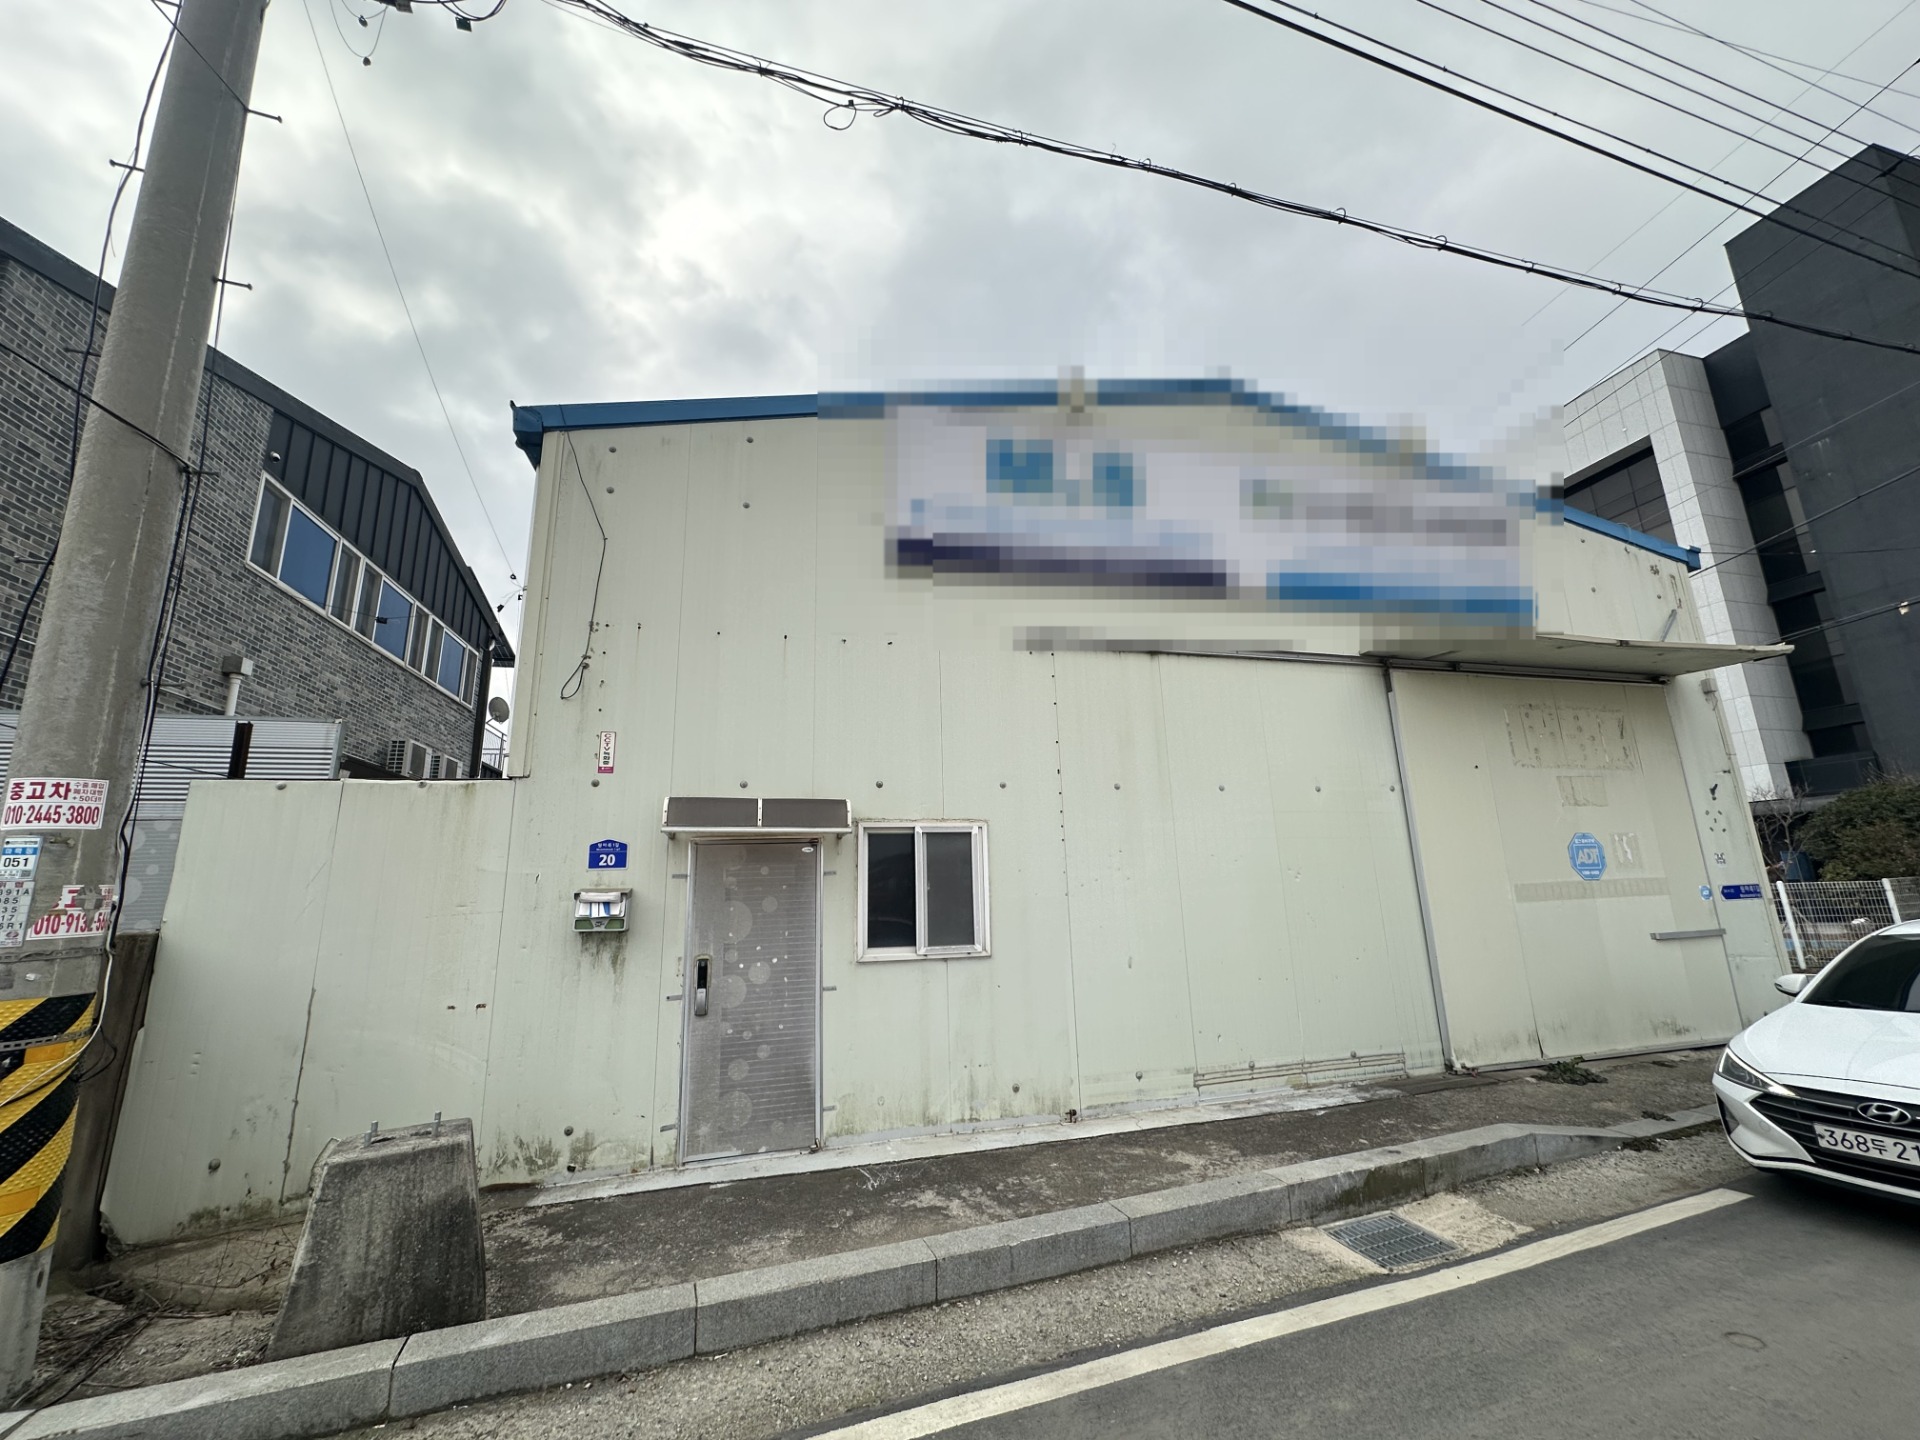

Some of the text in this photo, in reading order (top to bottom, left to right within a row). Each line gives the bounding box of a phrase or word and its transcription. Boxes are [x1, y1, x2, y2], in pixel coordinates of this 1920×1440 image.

[603, 733, 612, 751] CCTV
[10, 782, 71, 801] 중고차
[4, 804, 100, 825] 010-2445-3800
[3, 857, 29, 868] 051
[598, 853, 616, 866] 20
[1577, 847, 1599, 865] ADT
[1823, 1128, 1887, 1155] 368두
